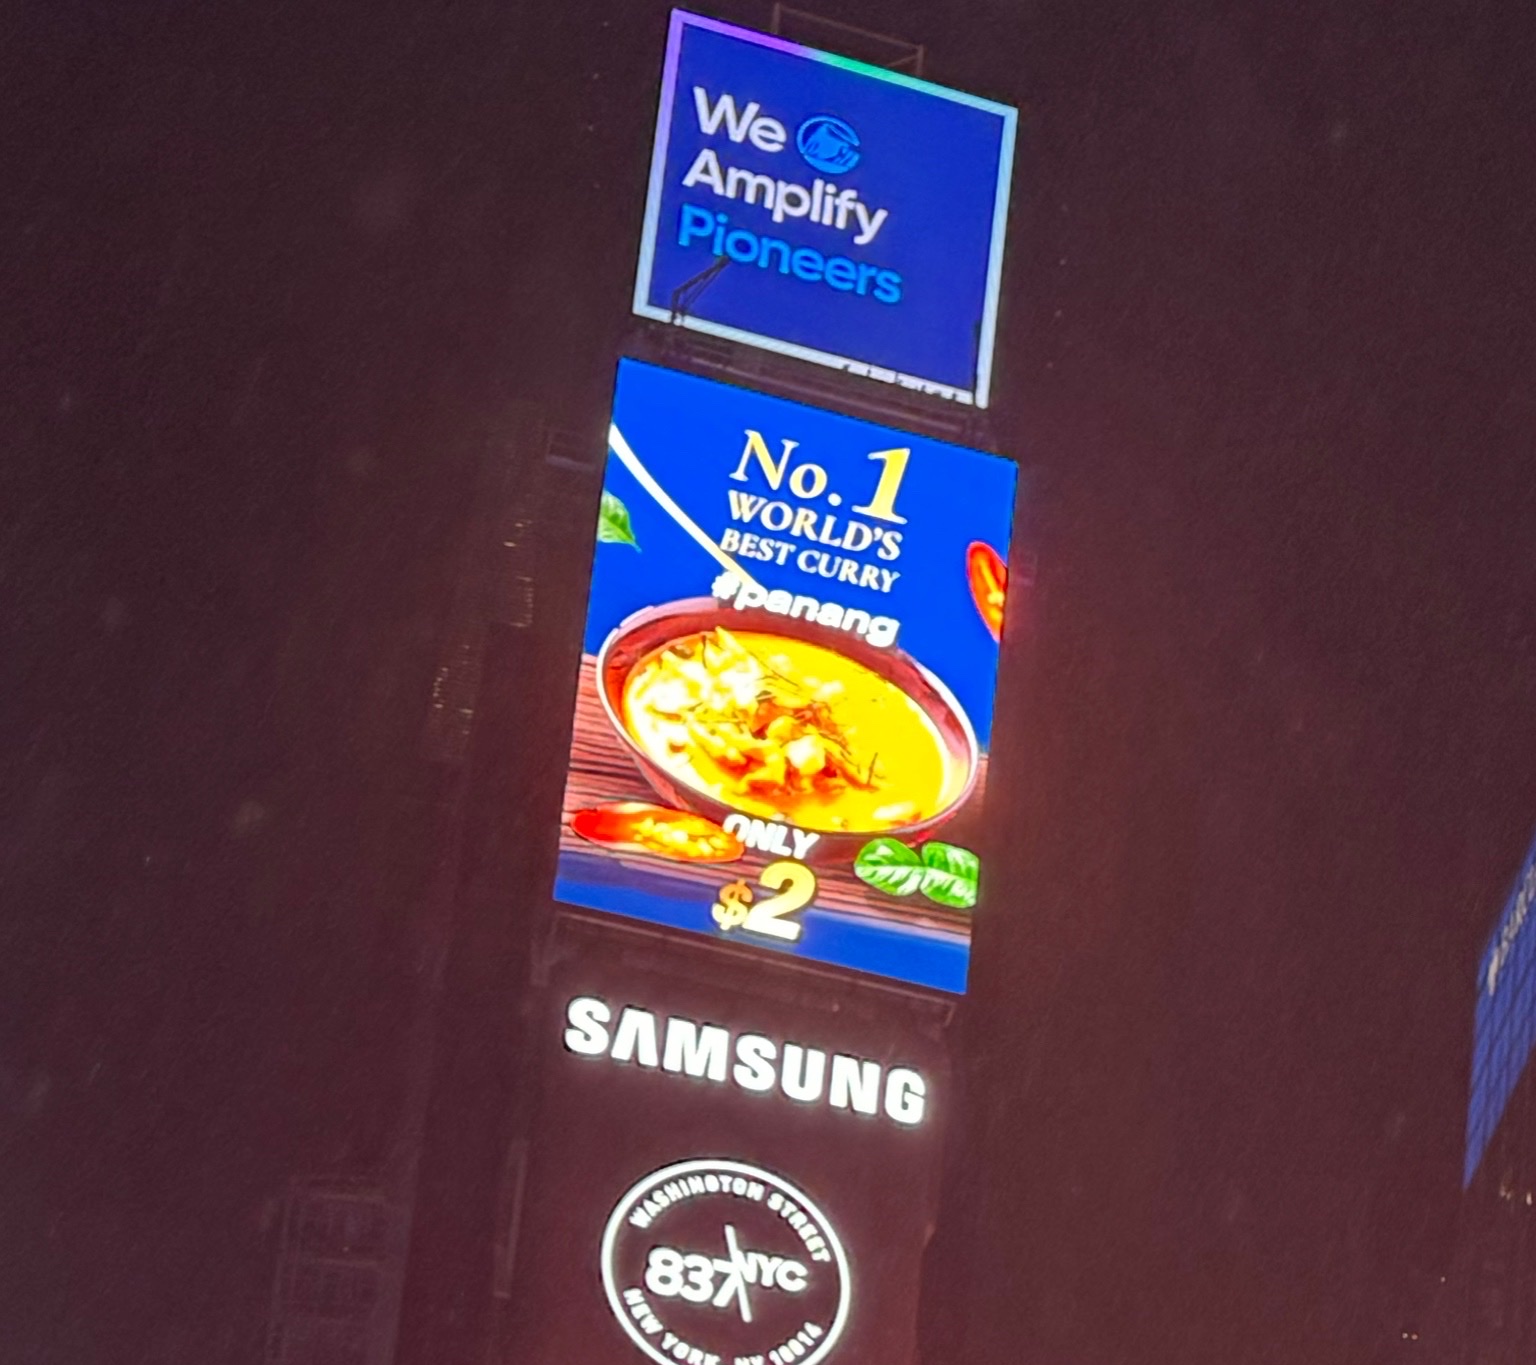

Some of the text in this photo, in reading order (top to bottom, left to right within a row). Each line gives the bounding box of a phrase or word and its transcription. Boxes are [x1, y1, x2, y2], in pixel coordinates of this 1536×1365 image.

[693, 86, 787, 153] We
[681, 149, 888, 245] Amplify
[678, 203, 903, 304] Pioneers
[729, 430, 912, 525] No. 1
[719, 528, 902, 594] BEST CURRY
[726, 489, 904, 562] WORLD'S
[711, 570, 900, 648] #panang
[722, 814, 821, 859] ONLY
[712, 862, 818, 942] $2
[565, 996, 927, 1125] SAMSUNG
[629, 1174, 832, 1262] WASHINGTON STREET
[623, 1287, 664, 1335] NEW
